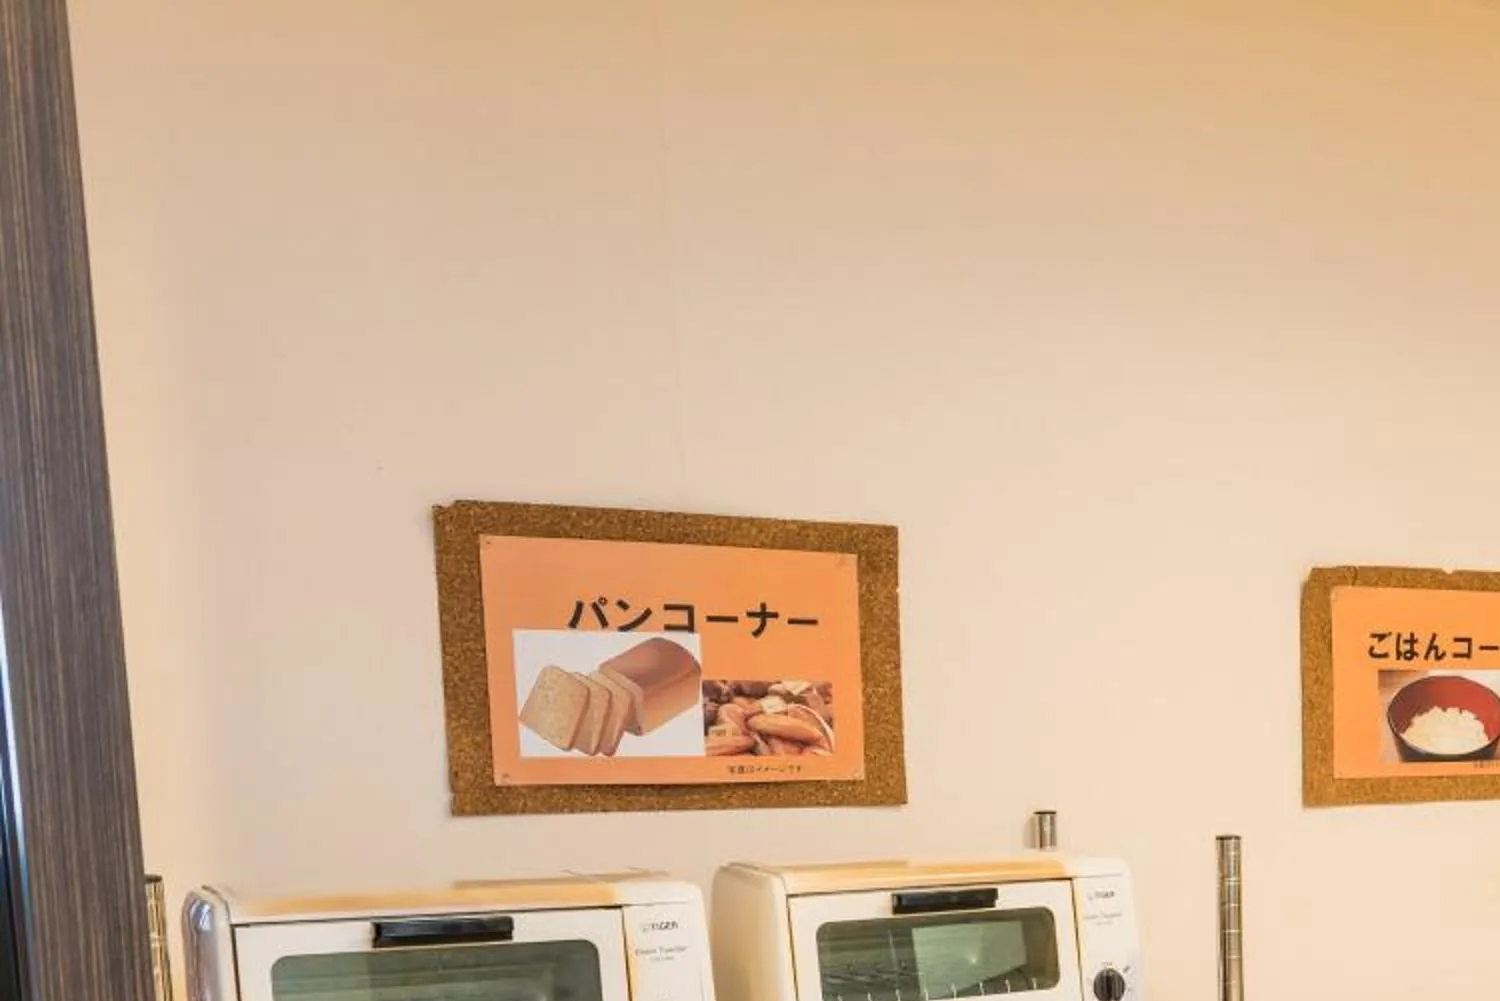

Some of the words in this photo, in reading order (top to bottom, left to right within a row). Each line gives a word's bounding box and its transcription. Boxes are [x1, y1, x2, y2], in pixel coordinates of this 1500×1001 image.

[567, 596, 819, 638] パンコーナー
